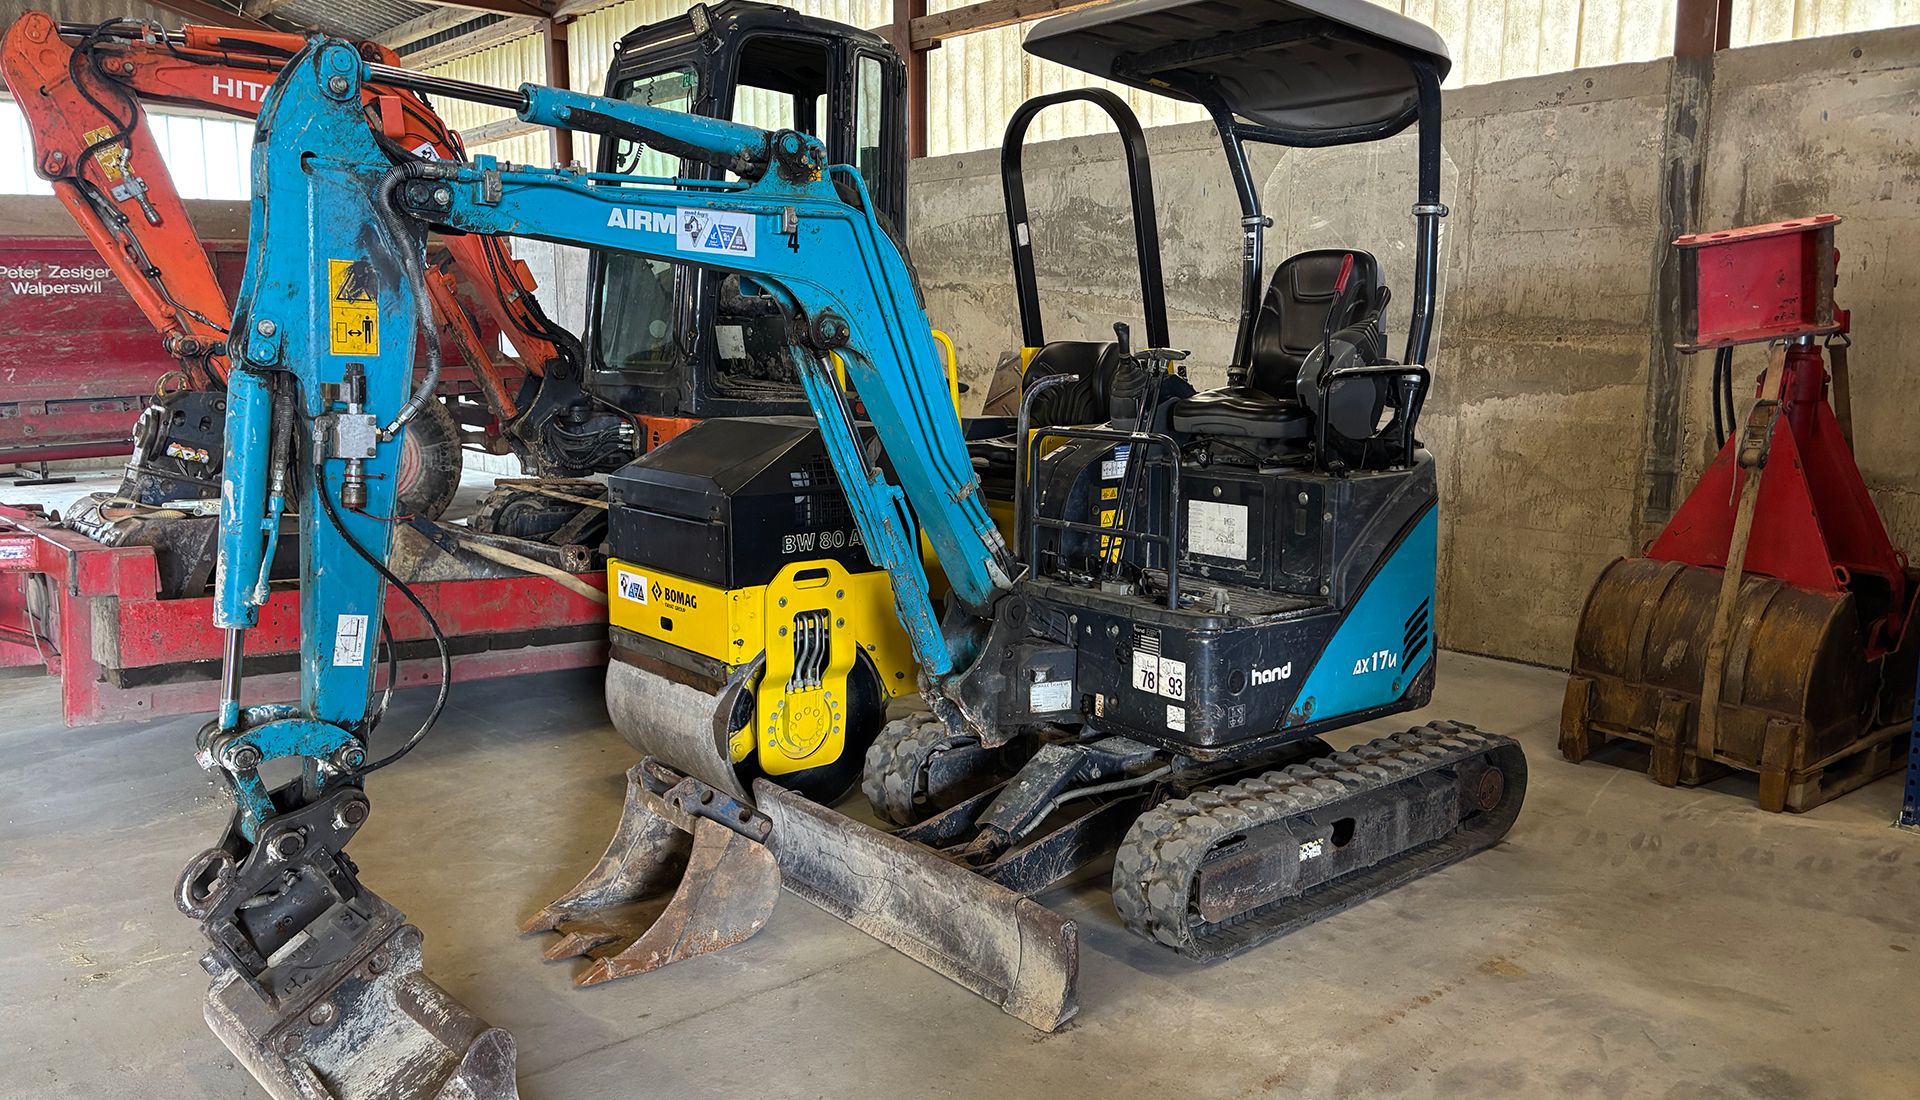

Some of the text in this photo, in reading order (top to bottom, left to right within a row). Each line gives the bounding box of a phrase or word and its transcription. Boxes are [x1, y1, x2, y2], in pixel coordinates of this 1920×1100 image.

[788, 225, 799, 253] 4
[0, 265, 112, 280] Peter Zesiger
[11, 281, 102, 297] Walperswil
[782, 532, 816, 554] BW
[819, 530, 845, 549] 80
[664, 587, 697, 609] BOMAG
[1141, 669, 1155, 690] 78
[1251, 661, 1292, 686] hand
[1168, 677, 1183, 696] 93
